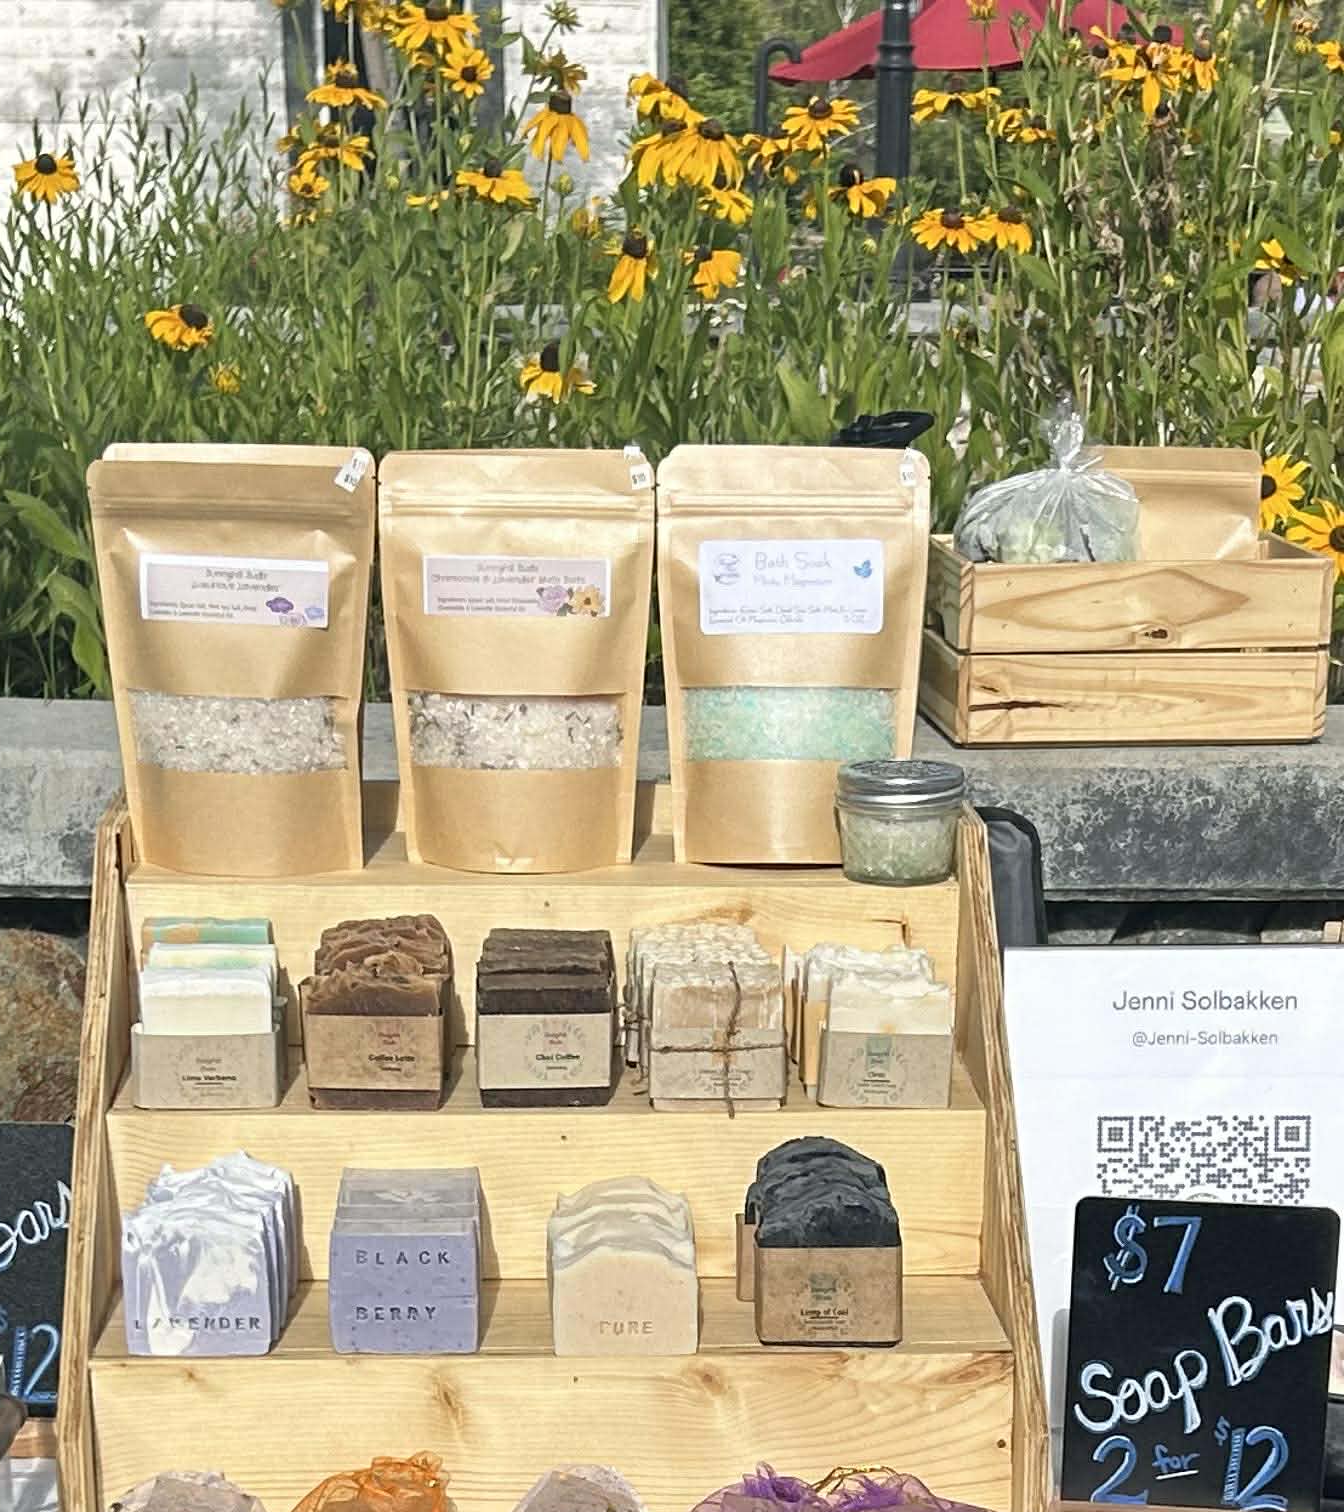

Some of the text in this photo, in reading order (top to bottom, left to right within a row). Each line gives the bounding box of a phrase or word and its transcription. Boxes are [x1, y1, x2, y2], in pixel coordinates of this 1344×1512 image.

[1112, 989, 1298, 1011] Jenni Solbakken
[1131, 1030, 1279, 1047] @Jenni-Solbakken
[356, 1249, 452, 1266] BLACK
[1102, 1204, 1202, 1294] $7
[355, 1305, 438, 1321] BERRY
[1208, 1287, 1335, 1387] Bars
[1073, 1350, 1208, 1434] Soap
[1090, 1415, 1290, 1512] 2 for $12
